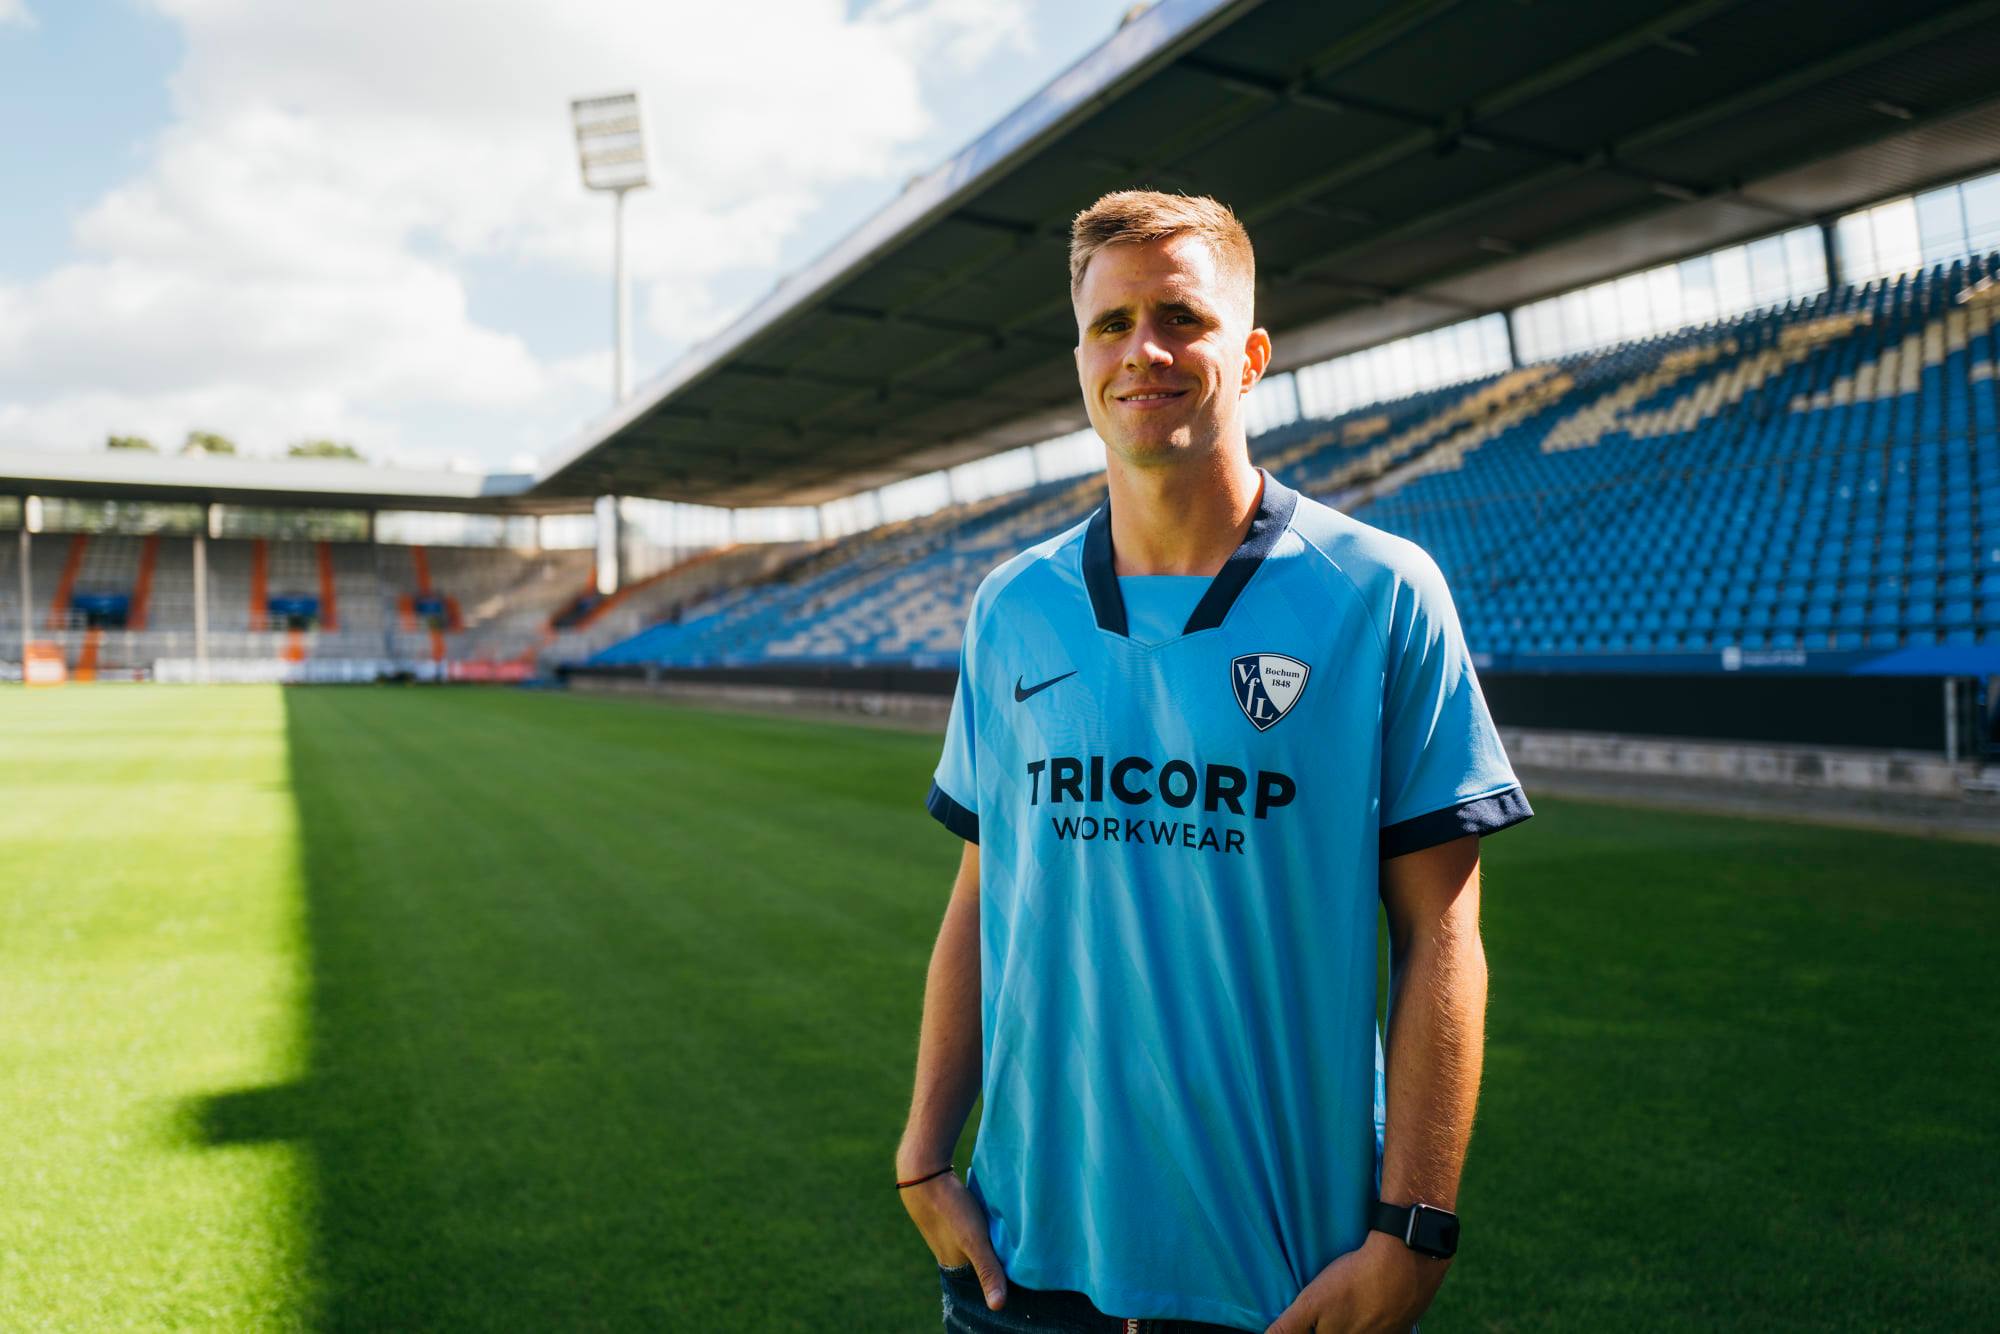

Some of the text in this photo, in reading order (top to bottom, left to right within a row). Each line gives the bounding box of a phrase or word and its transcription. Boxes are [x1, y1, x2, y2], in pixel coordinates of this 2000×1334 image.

[1236, 663, 1274, 720] VfL
[1265, 667, 1300, 679] Bochum
[1272, 679, 1291, 688] 1848
[1027, 756, 1296, 819] TRICORP
[1052, 816, 1245, 855] WORKWEAR
